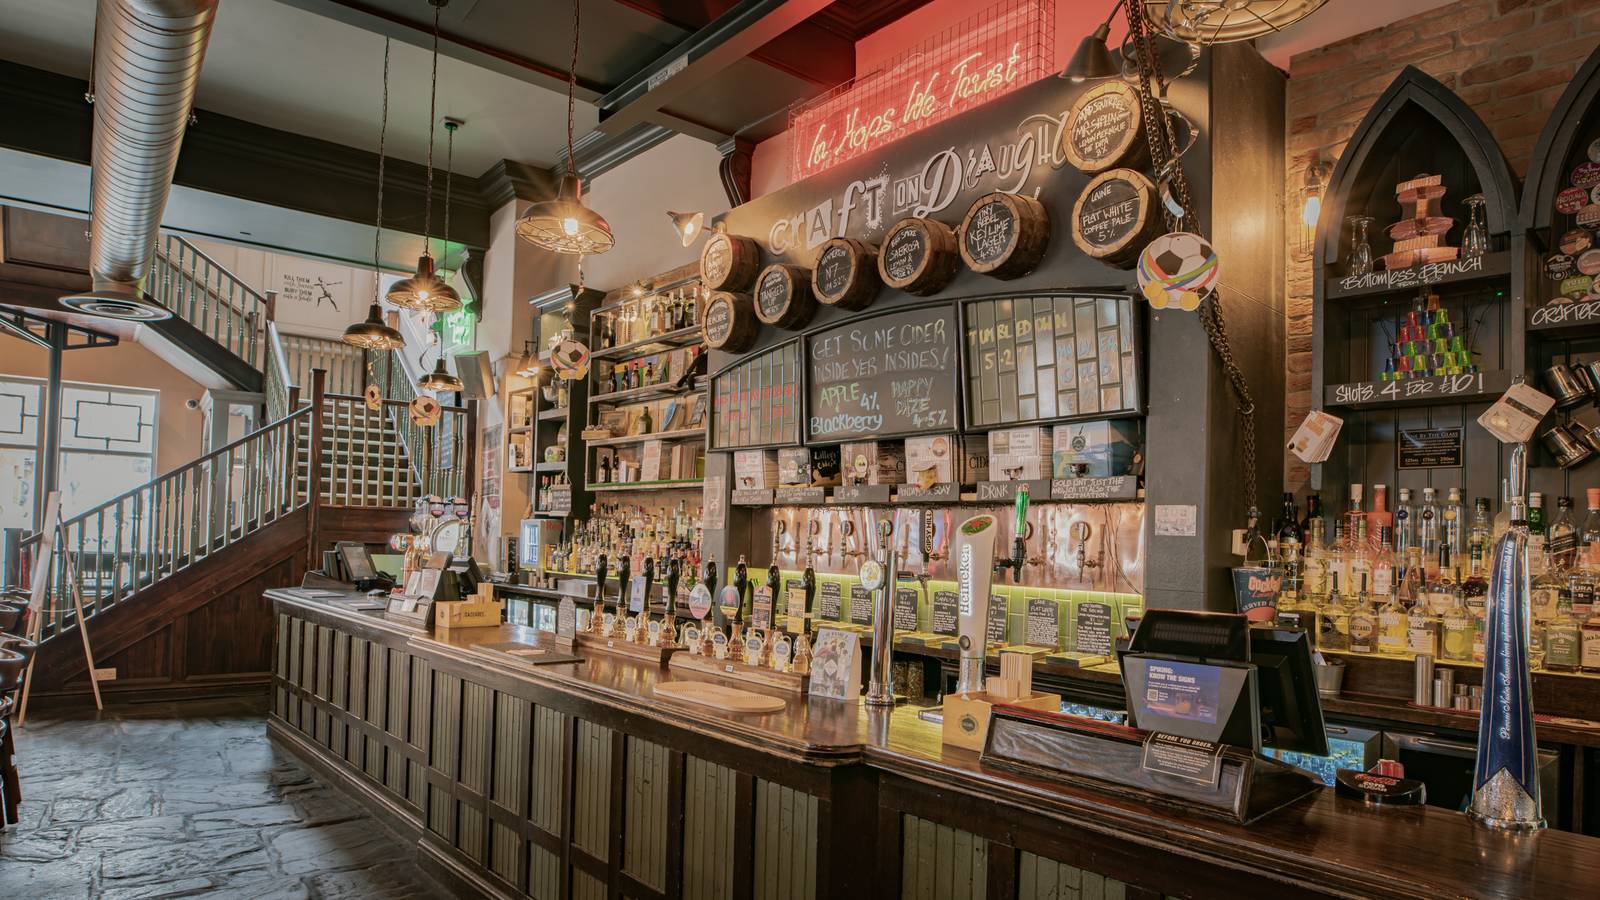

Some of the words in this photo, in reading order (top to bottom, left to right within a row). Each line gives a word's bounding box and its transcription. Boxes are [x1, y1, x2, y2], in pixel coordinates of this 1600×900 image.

[1091, 184, 1112, 202] LAINE
[1082, 209, 1103, 227] FLAT
[1103, 200, 1133, 219] WHITE
[1084, 219, 1110, 235] COFFEE
[1111, 212, 1132, 227] PALE
[969, 225, 987, 245] KEY
[977, 230, 1006, 251] LAGER
[1098, 228, 1116, 241] 5%
[812, 335, 844, 360] GET
[900, 318, 946, 346] CIDER
[814, 360, 850, 384] INSIDE
[852, 356, 877, 377] YER
[884, 345, 949, 371] INSIDES!
[819, 382, 860, 413] APPLE
[1380, 380, 1400, 400] 4
[981, 484, 1009, 499] DRINK
[959, 543, 972, 616] Heineken
[1149, 672, 1166, 680] KNOW
[1166, 674, 1177, 682] THE
[1499, 712, 1511, 740] Peroni
[1157, 733, 1179, 742] BEFORE
[1180, 736, 1191, 745] YOU
